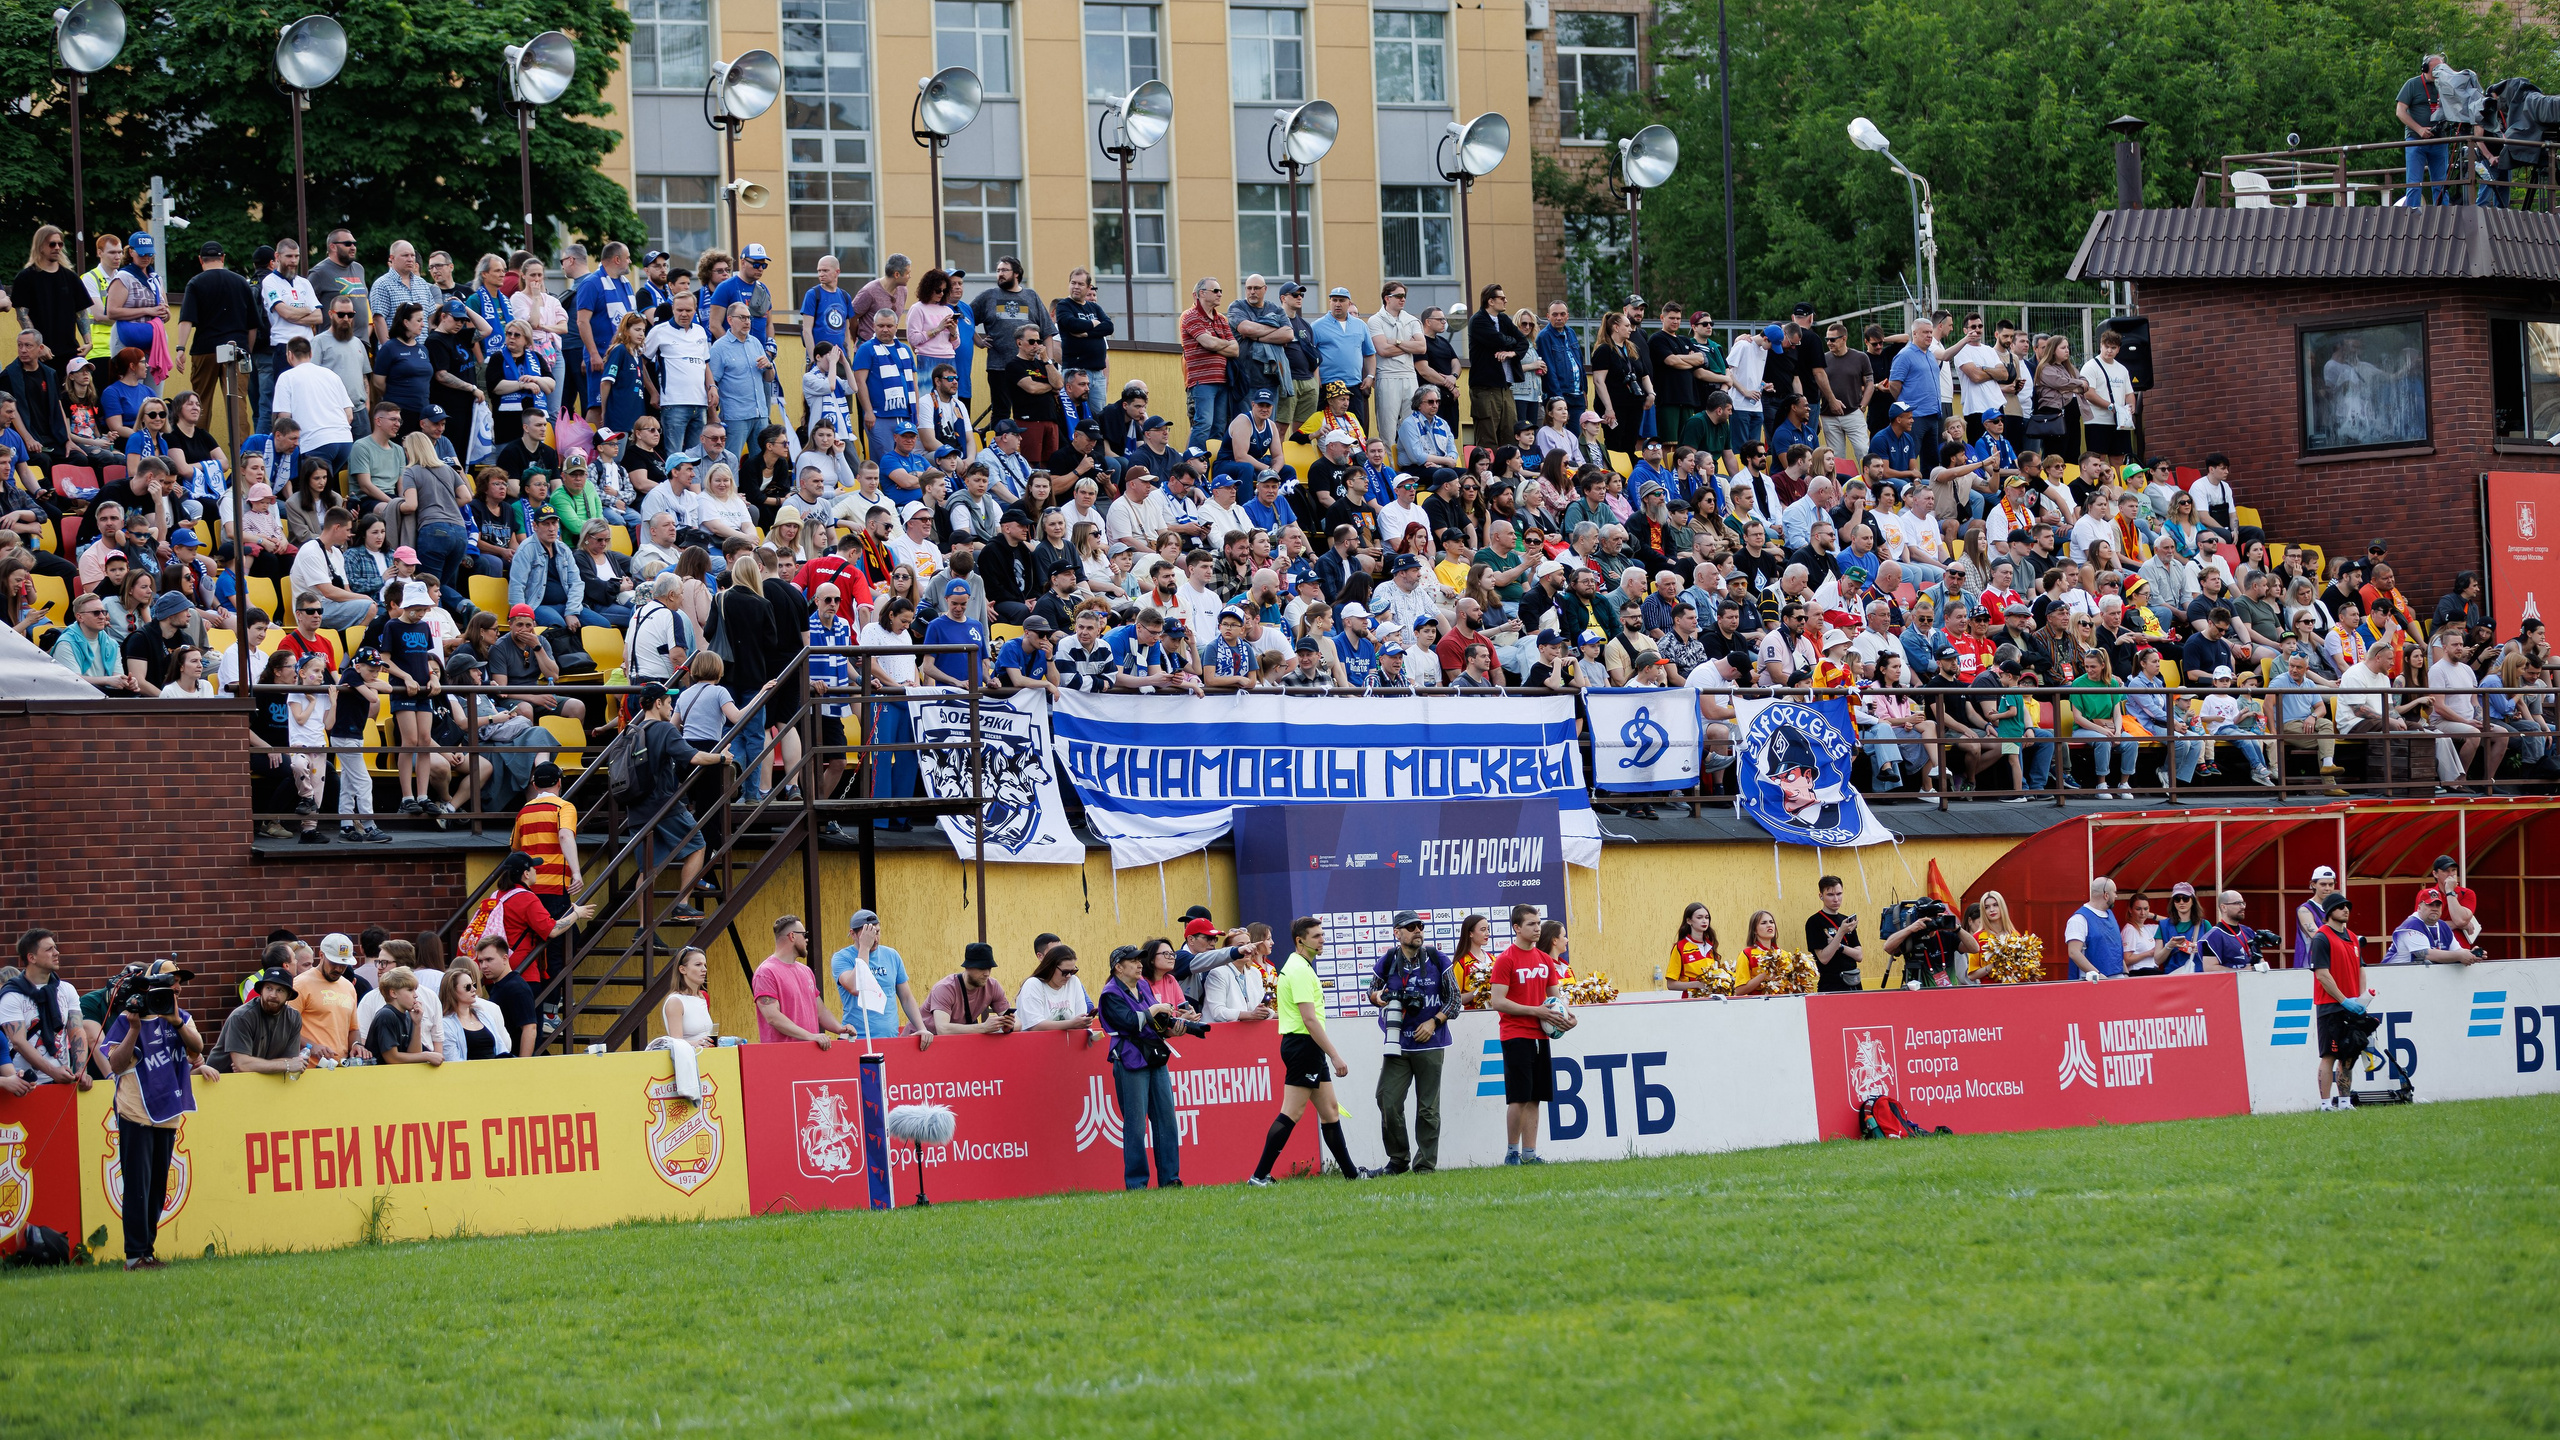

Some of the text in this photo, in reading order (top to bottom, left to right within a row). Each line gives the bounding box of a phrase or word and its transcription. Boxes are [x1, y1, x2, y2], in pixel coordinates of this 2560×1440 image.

[1767, 646, 1775, 658] 8
[1747, 706, 1848, 760] ENFORCERS
[1068, 740, 1575, 797] ДИНАМОВЦЫ МОСКВЫ
[1419, 836, 1544, 876] РЕГБИ РОССИИ
[1905, 1025, 2003, 1050] Департамент
[2099, 1008, 2208, 1052] МОСКОВСКИЙ
[2514, 1005, 2560, 1073] ВТ
[1169, 1058, 1272, 1107] КОВСКИЙ
[1907, 1056, 1959, 1077] спорта
[2102, 1053, 2153, 1088] СПОРТ
[654, 1083, 678, 1096] RUGB
[888, 1079, 1003, 1101] епартамент
[1548, 1051, 1676, 1141] ВТБ
[1910, 1079, 2024, 1106] города Москвы
[0, 1129, 19, 1140] LUB
[245, 1111, 600, 1194] РЕГБИ КЛУБ СЛАВА
[889, 1139, 1029, 1171] орода Москвы
[679, 1175, 697, 1185] 1974
